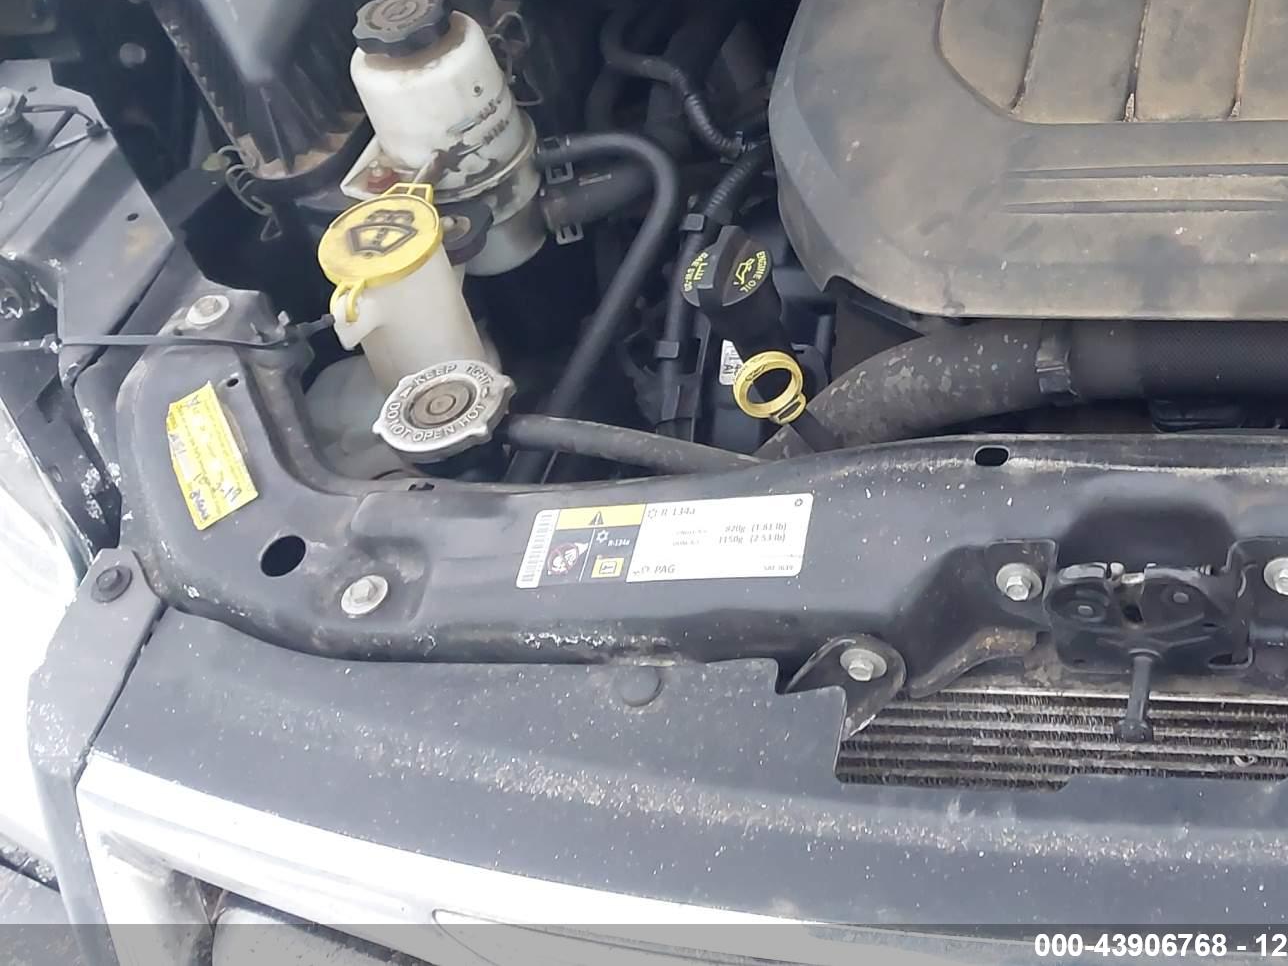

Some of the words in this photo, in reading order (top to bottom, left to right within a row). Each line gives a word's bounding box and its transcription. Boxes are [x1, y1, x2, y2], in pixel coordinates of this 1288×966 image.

[756, 250, 768, 282] ENGINE
[739, 280, 757, 294] OIL
[413, 363, 458, 386] KEEP
[465, 363, 495, 389] TIGHT
[386, 400, 402, 419] DO
[459, 403, 486, 429] HOT
[387, 416, 412, 439] NOT
[412, 425, 457, 443] OPEN
[654, 564, 676, 574] PAG
